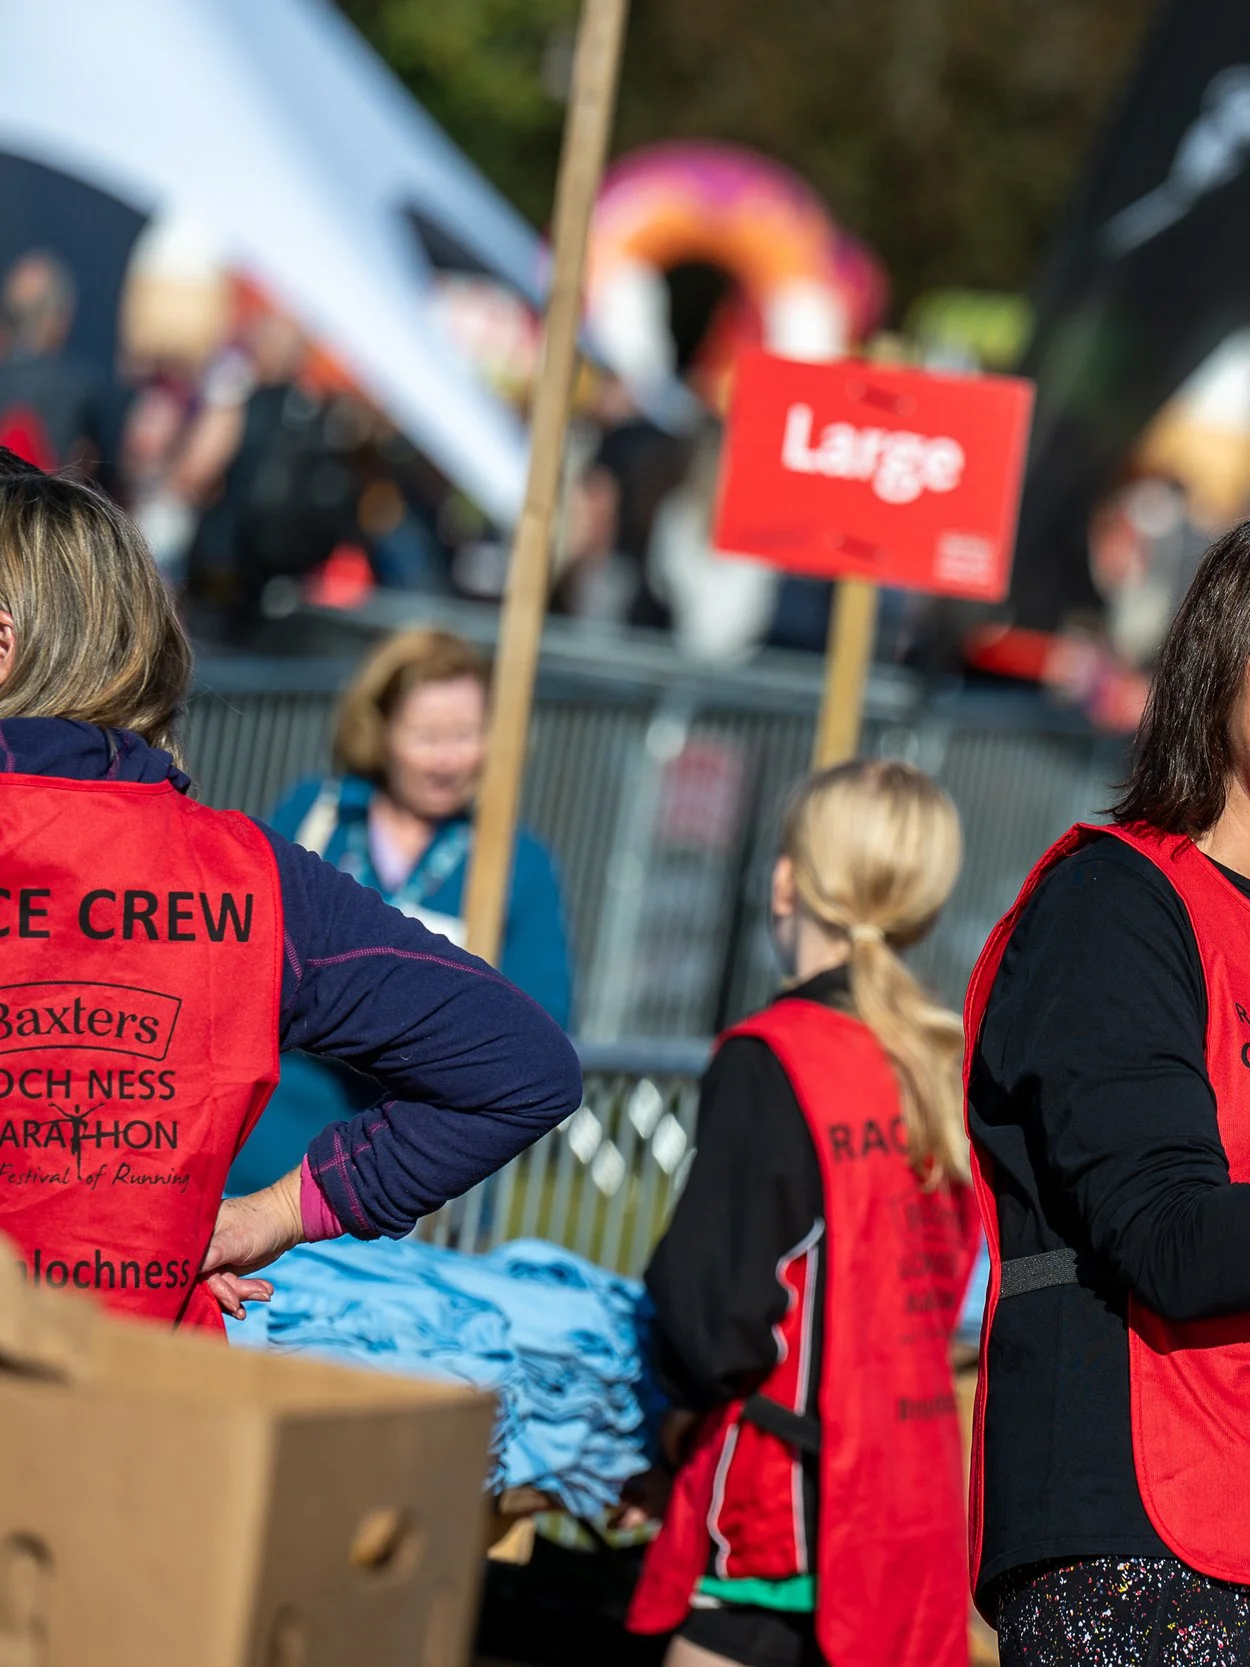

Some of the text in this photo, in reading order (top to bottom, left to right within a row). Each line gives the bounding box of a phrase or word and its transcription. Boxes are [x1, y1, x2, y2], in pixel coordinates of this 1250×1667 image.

[781, 402, 966, 505] Large
[78, 889, 253, 942] CREW
[88, 1070, 176, 1100] NESS
[86, 1163, 107, 1190] of
[112, 1162, 190, 1194] Running
